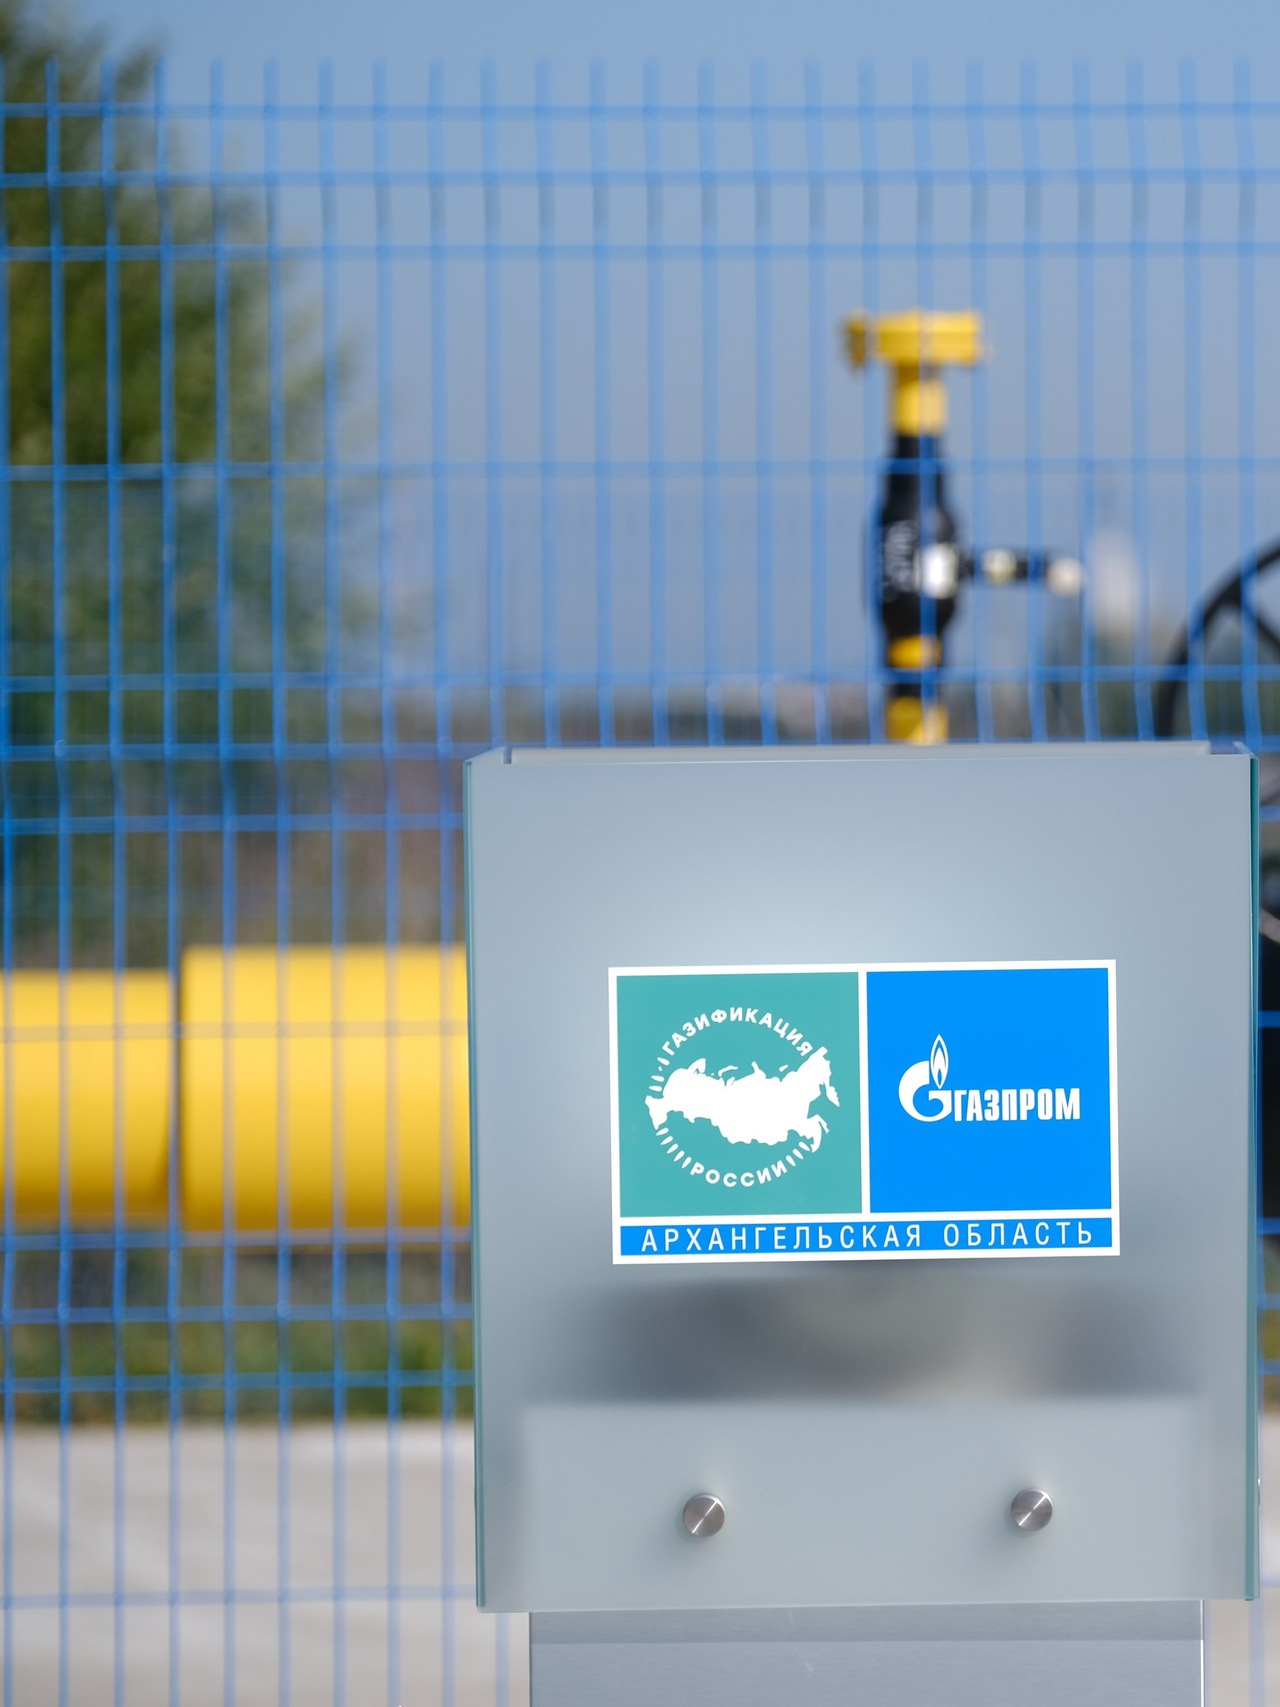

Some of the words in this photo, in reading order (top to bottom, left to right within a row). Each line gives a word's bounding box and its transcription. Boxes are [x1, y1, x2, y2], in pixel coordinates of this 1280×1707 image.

[661, 1006, 814, 1057] ГАЗИФИКАЦИЯ
[953, 1087, 1081, 1122] ГАЗПРОМ
[689, 1160, 788, 1188] РОССИИ
[641, 1224, 921, 1252] АРХАНГЕЛЬСКАЯ
[943, 1221, 1093, 1247] ОБЛАСТЬ
